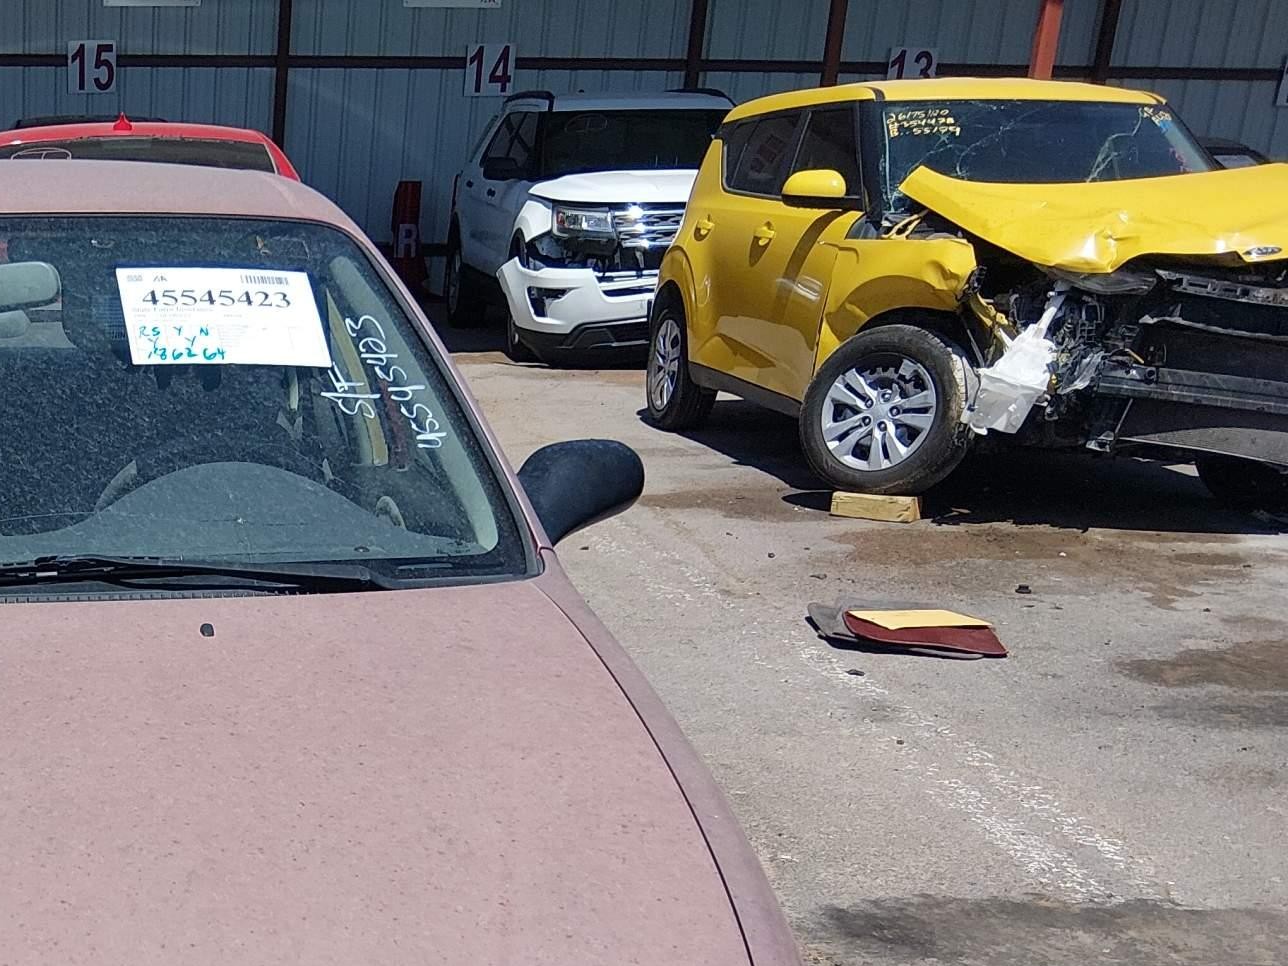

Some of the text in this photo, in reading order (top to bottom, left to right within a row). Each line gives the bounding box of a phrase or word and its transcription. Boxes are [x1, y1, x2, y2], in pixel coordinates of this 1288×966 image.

[71, 43, 114, 91] 15
[469, 45, 511, 93] 14
[397, 224, 418, 258] R
[142, 289, 292, 309] 45545423
[199, 325, 210, 337] N
[345, 315, 447, 448] 45545423
